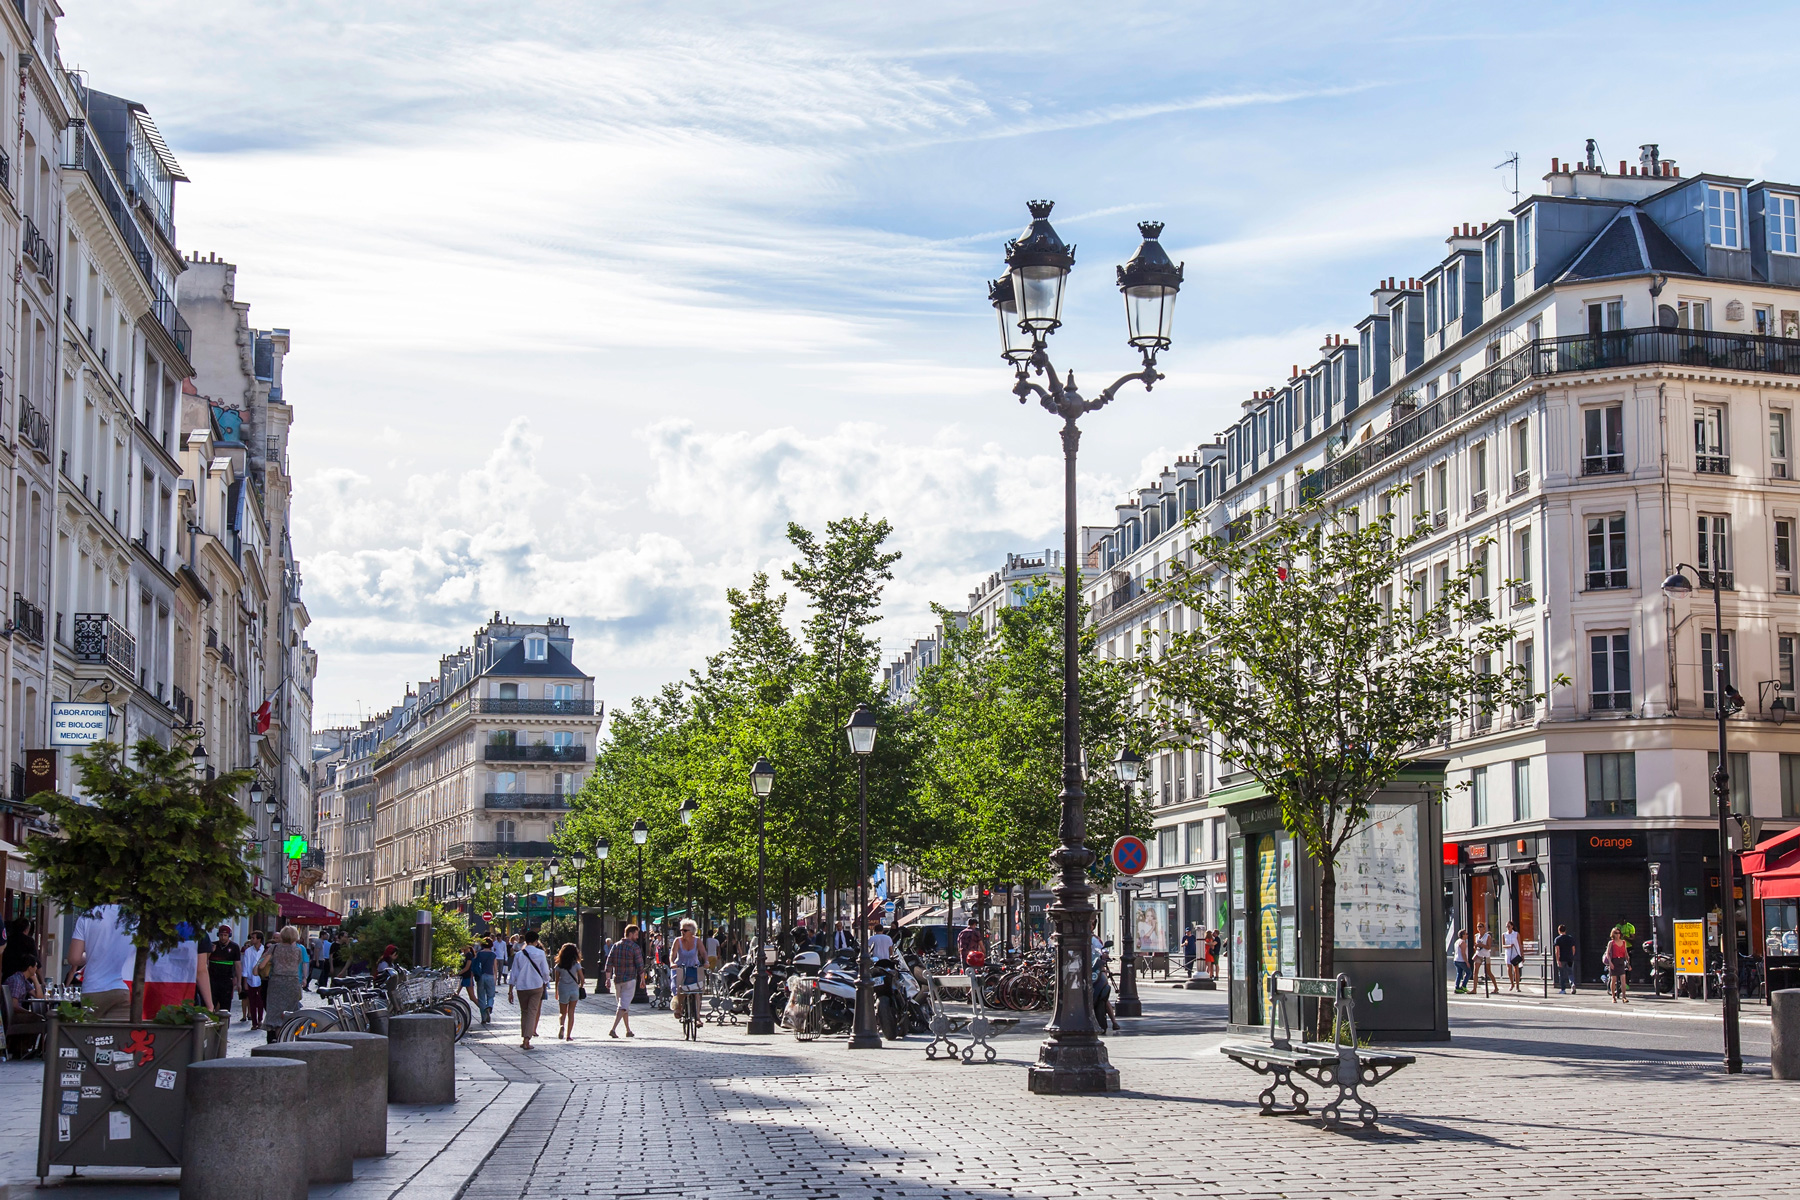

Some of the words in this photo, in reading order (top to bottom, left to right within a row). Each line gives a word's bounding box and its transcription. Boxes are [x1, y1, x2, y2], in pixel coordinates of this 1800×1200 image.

[1590, 836, 1633, 850] Orange
[1470, 845, 1486, 857] Orange
[291, 859, 299, 882] ABAC
